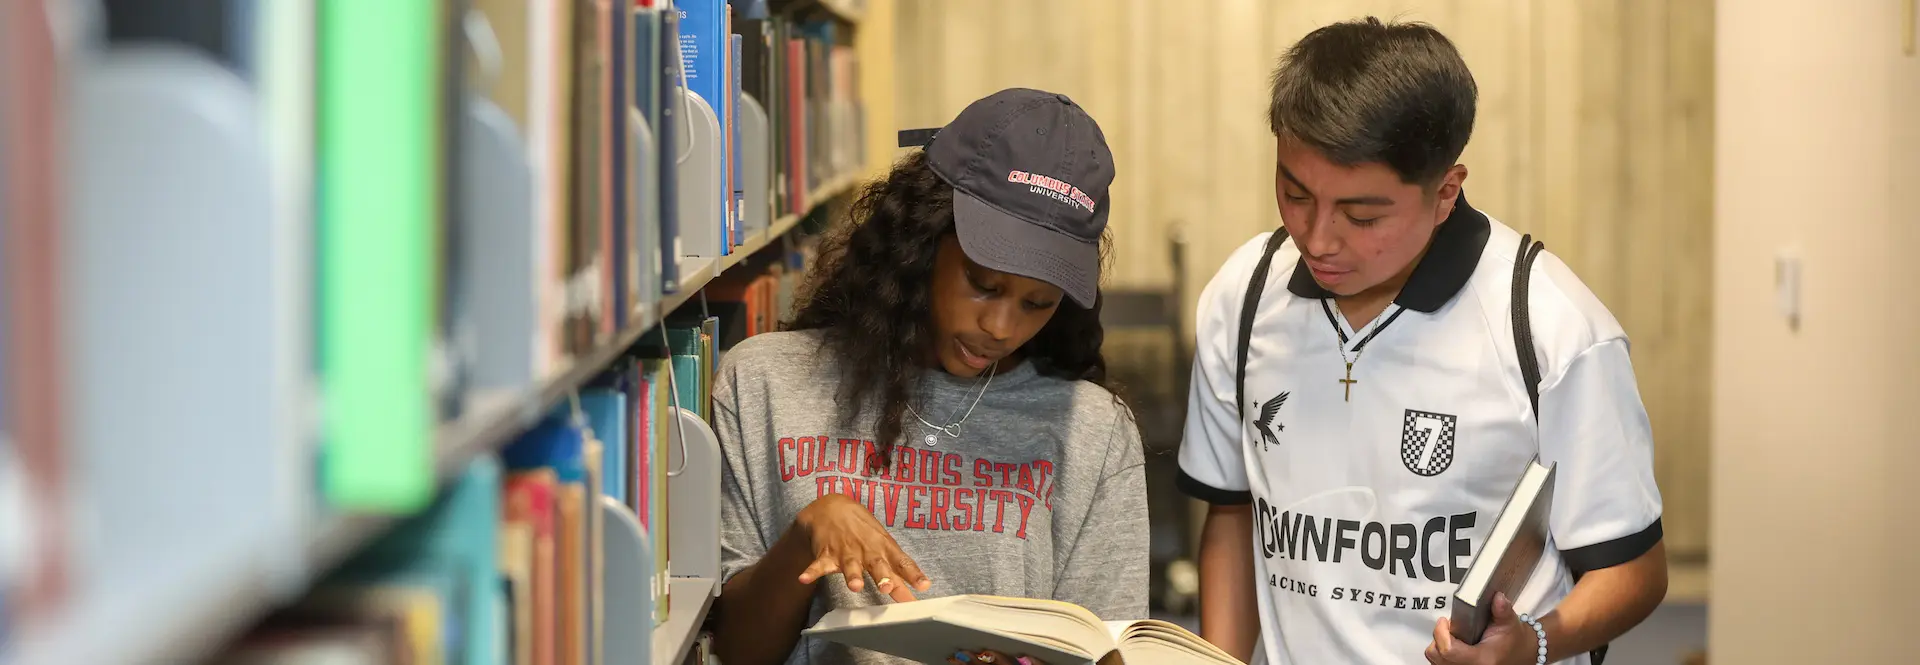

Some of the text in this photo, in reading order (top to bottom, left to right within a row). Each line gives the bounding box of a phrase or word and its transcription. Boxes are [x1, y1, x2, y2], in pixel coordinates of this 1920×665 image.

[1008, 170, 1095, 213] COLUMBUS STATE
[1030, 186, 1080, 209] UNIVERSITY
[777, 435, 963, 486] COLUMBUS
[1414, 416, 1446, 470] 7
[1252, 496, 1477, 585] OWNFORCE
[1269, 573, 1447, 611] ACING SYSTEMS
